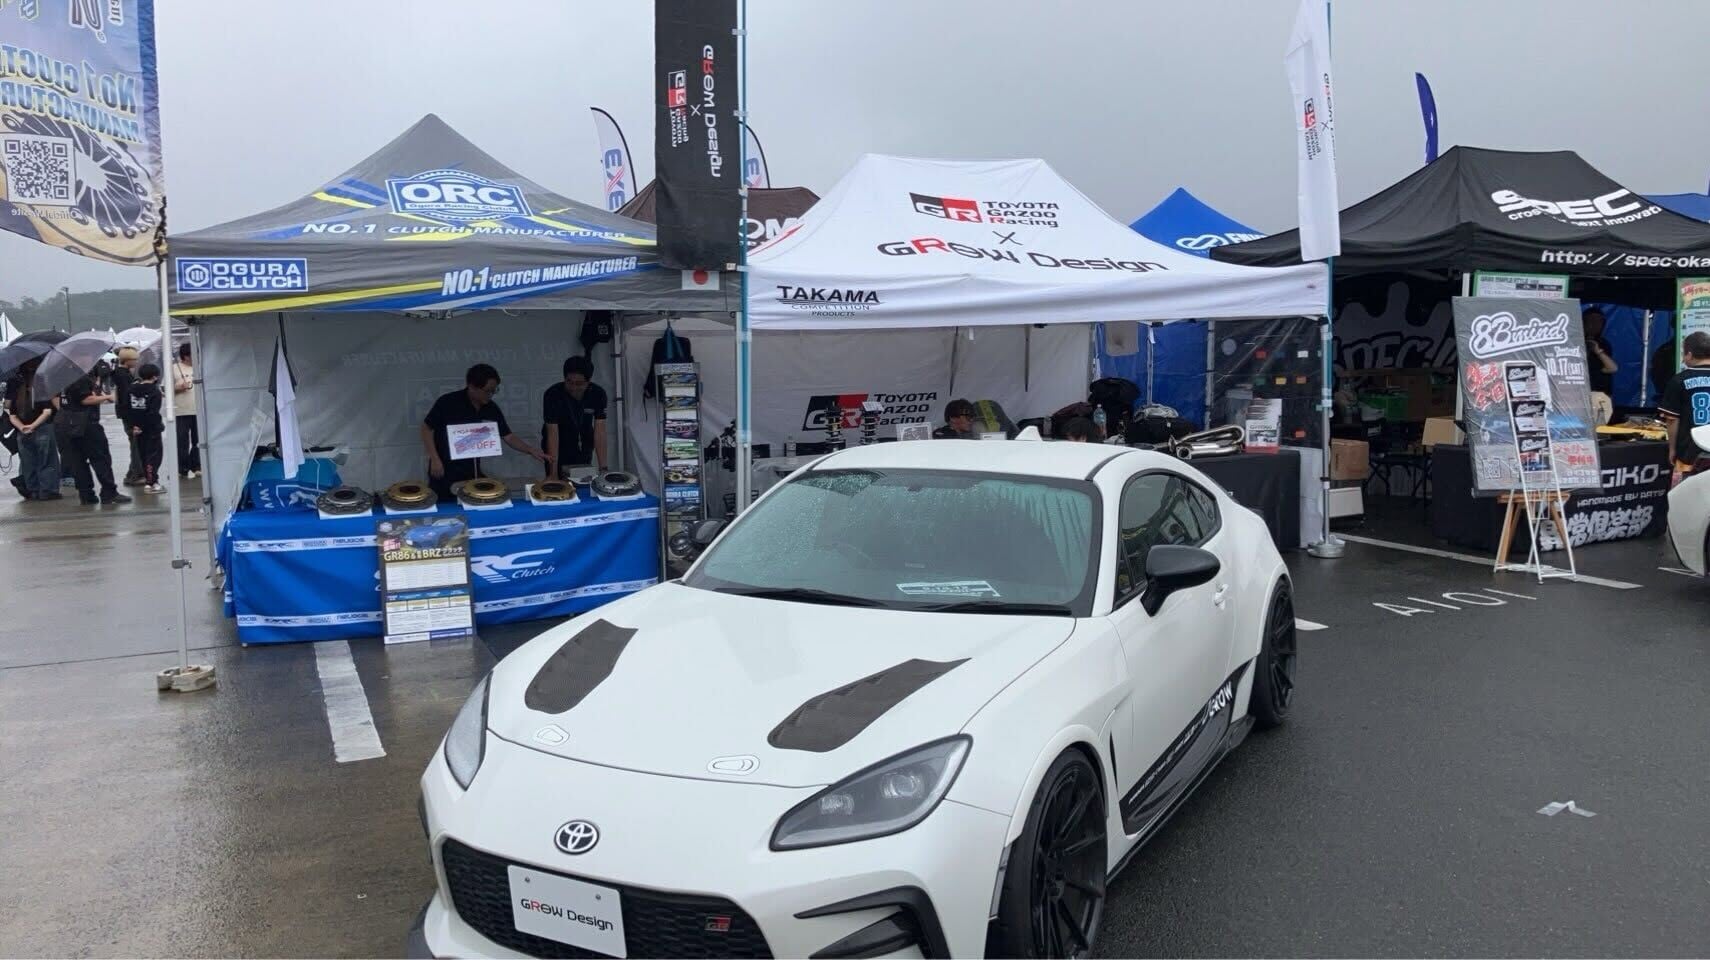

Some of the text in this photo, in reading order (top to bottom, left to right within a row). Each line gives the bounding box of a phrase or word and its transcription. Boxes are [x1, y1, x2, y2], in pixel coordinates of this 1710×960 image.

[401, 183, 514, 206] ORC
[983, 201, 1060, 210] TOYOTA
[986, 209, 1056, 218] GAZOO
[990, 217, 1059, 228] Racing
[302, 223, 626, 239] NO.1 CLUTCH MANUFACTURER
[877, 238, 1169, 273] GROW Design
[212, 263, 301, 275] OGURA
[442, 256, 637, 296] NO.1 CLUTCH MANUFACTURER
[213, 276, 302, 289] CLUTCH
[776, 285, 880, 303] TAKAMA
[874, 391, 937, 404] TOYOTA
[1691, 391, 1710, 425] 8
[879, 414, 926, 426] acing
[383, 550, 410, 562] GR86
[511, 564, 556, 580] Clutch
[520, 897, 614, 931] GROW Design
